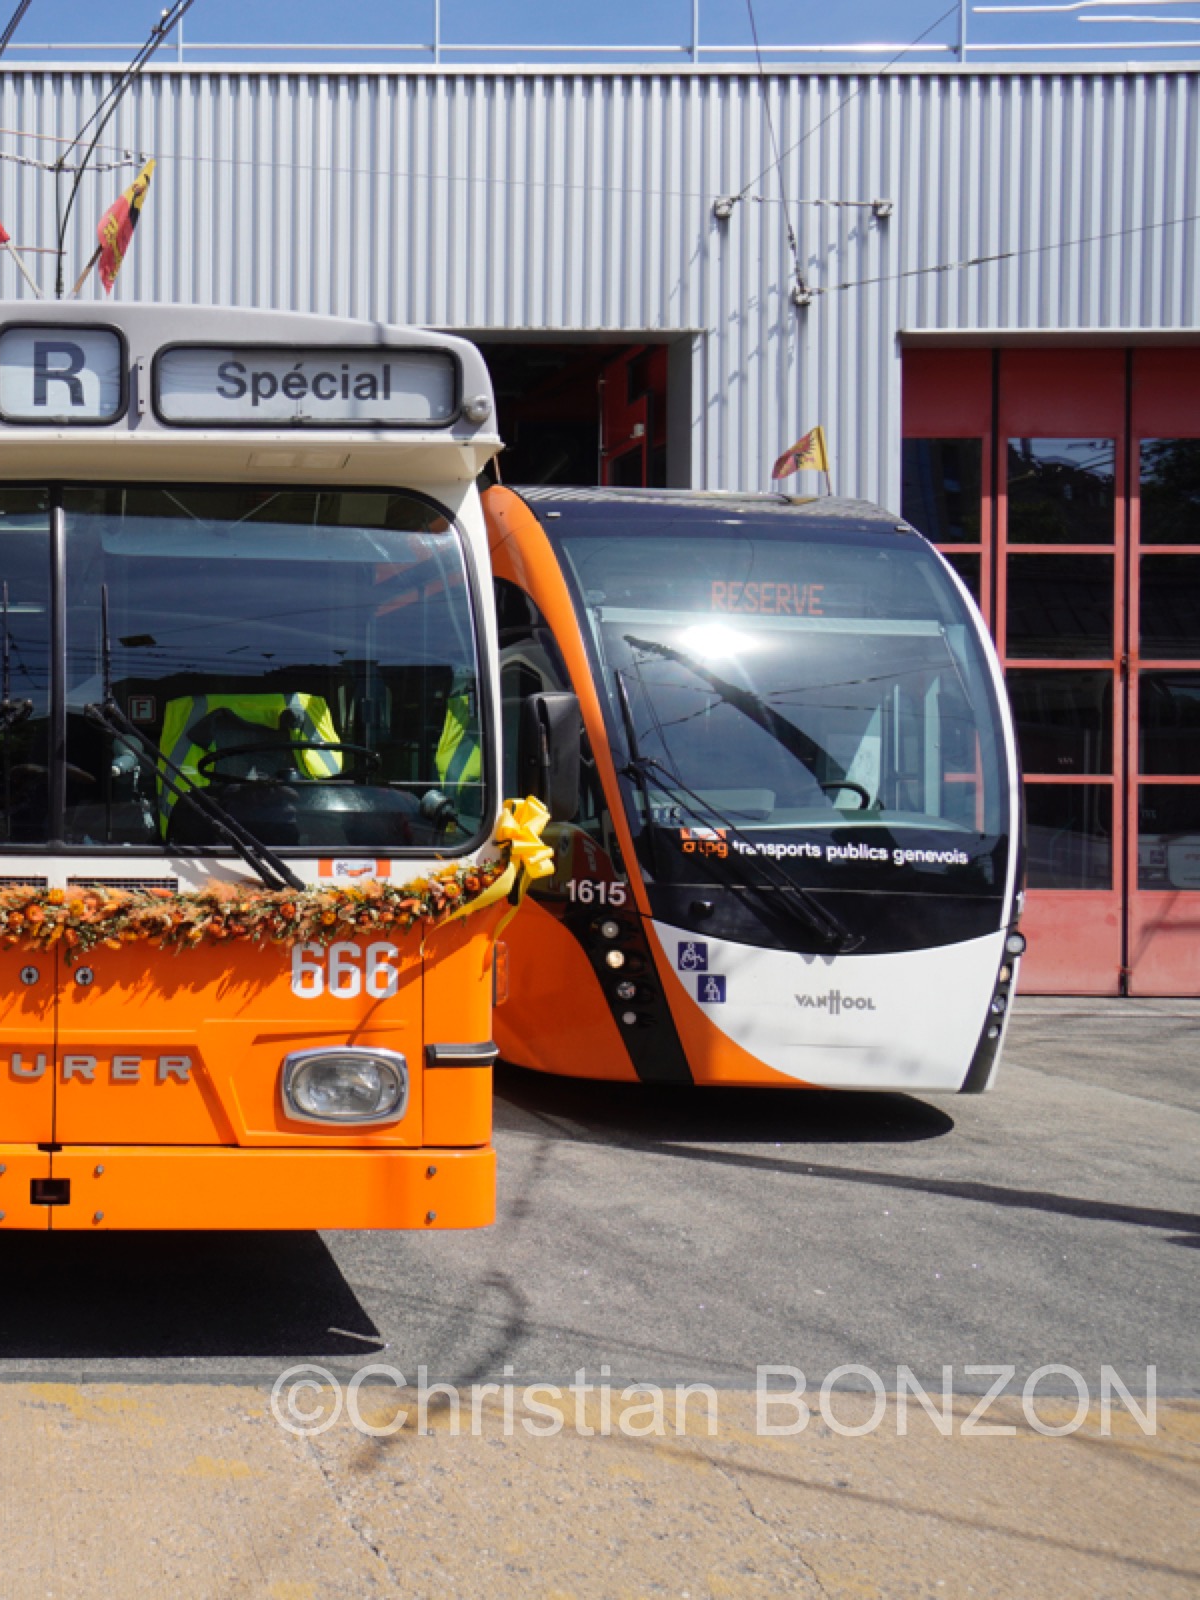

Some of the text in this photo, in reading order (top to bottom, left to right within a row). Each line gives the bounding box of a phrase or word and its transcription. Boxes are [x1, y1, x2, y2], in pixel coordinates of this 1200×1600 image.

[33, 341, 87, 407] R
[215, 360, 392, 407] Spécial
[710, 581, 825, 615] RESERVE
[826, 842, 888, 862] publics
[893, 848, 968, 865] genevois
[565, 879, 627, 906] 1615
[290, 941, 399, 999] 666
